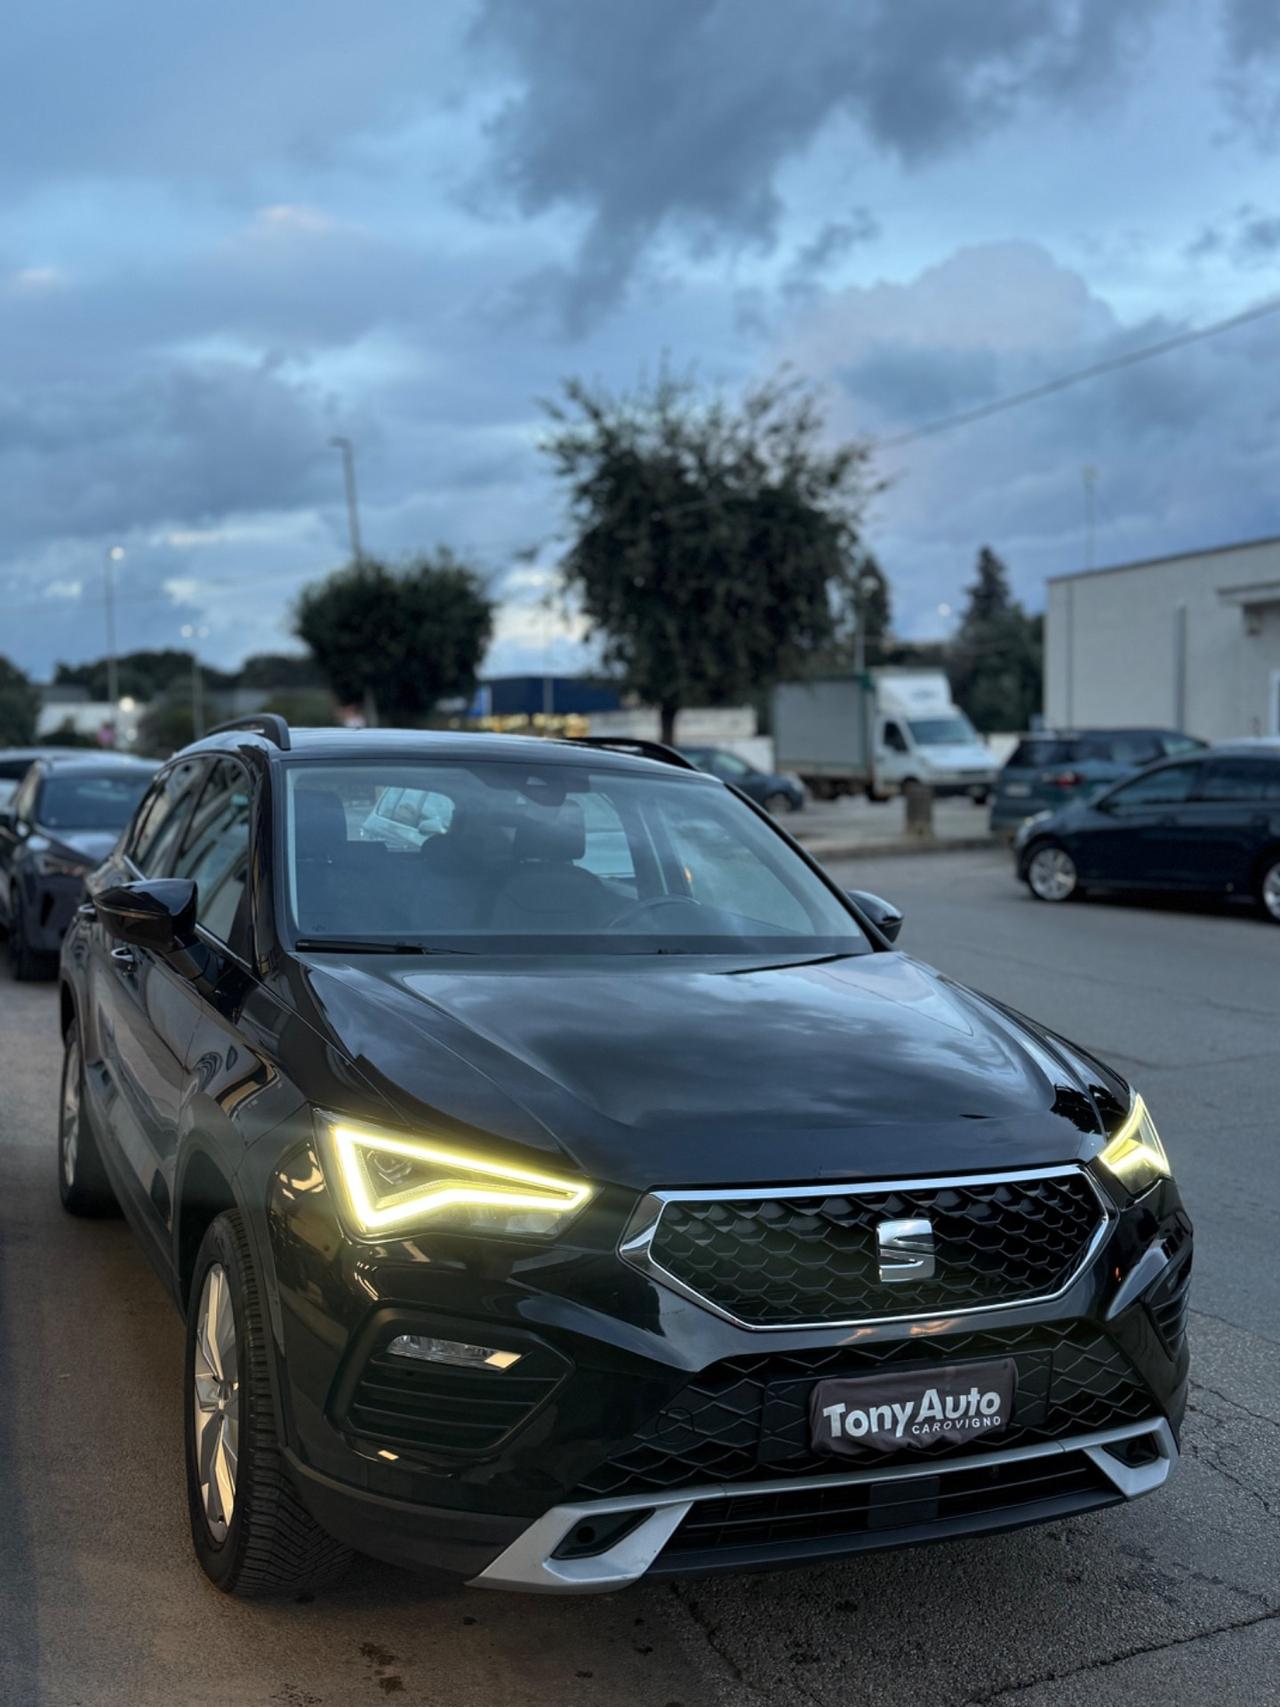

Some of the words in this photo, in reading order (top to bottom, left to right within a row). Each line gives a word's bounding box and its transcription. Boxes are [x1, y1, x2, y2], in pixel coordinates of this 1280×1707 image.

[823, 1401, 915, 1438] Tony
[915, 1387, 1001, 1423] Auto
[911, 1416, 1001, 1434] CAROVIGNO
